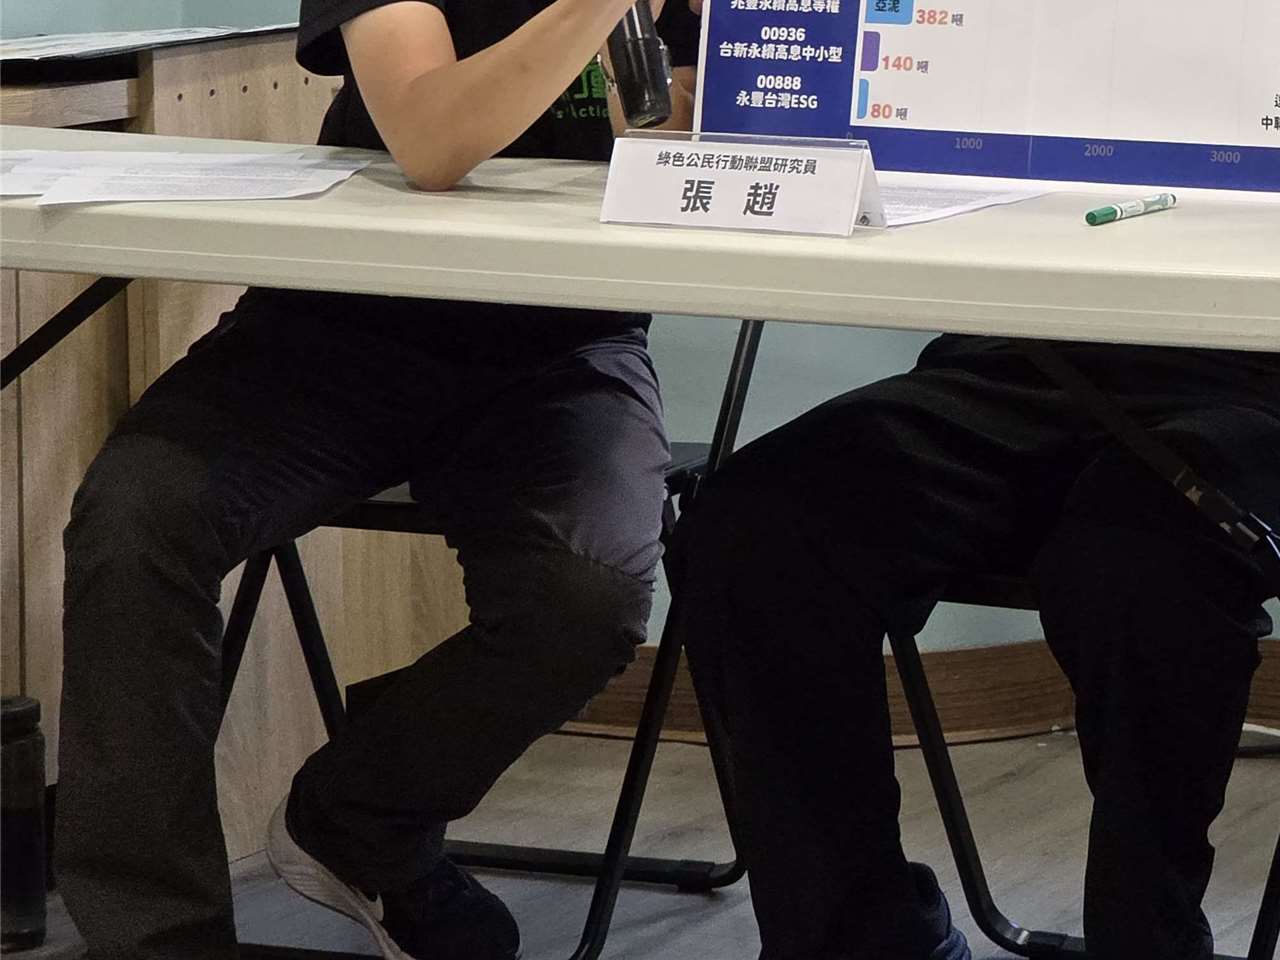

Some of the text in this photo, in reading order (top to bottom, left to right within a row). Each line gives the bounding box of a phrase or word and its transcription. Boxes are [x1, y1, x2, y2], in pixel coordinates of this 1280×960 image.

[916, 9, 949, 25] 382
[761, 26, 805, 41] 00936
[719, 41, 842, 62] 台新永續高息中小型
[882, 55, 913, 71] 140
[757, 75, 801, 89] 00888
[736, 90, 818, 109] 永豐台灣ESG
[870, 103, 893, 119] 80
[954, 137, 983, 150] 1000
[1084, 144, 1114, 158] 2000
[1210, 150, 1241, 164] 3000
[656, 151, 817, 175] 綠色公民行動聯盟研究員
[680, 179, 780, 216] 張 趙
